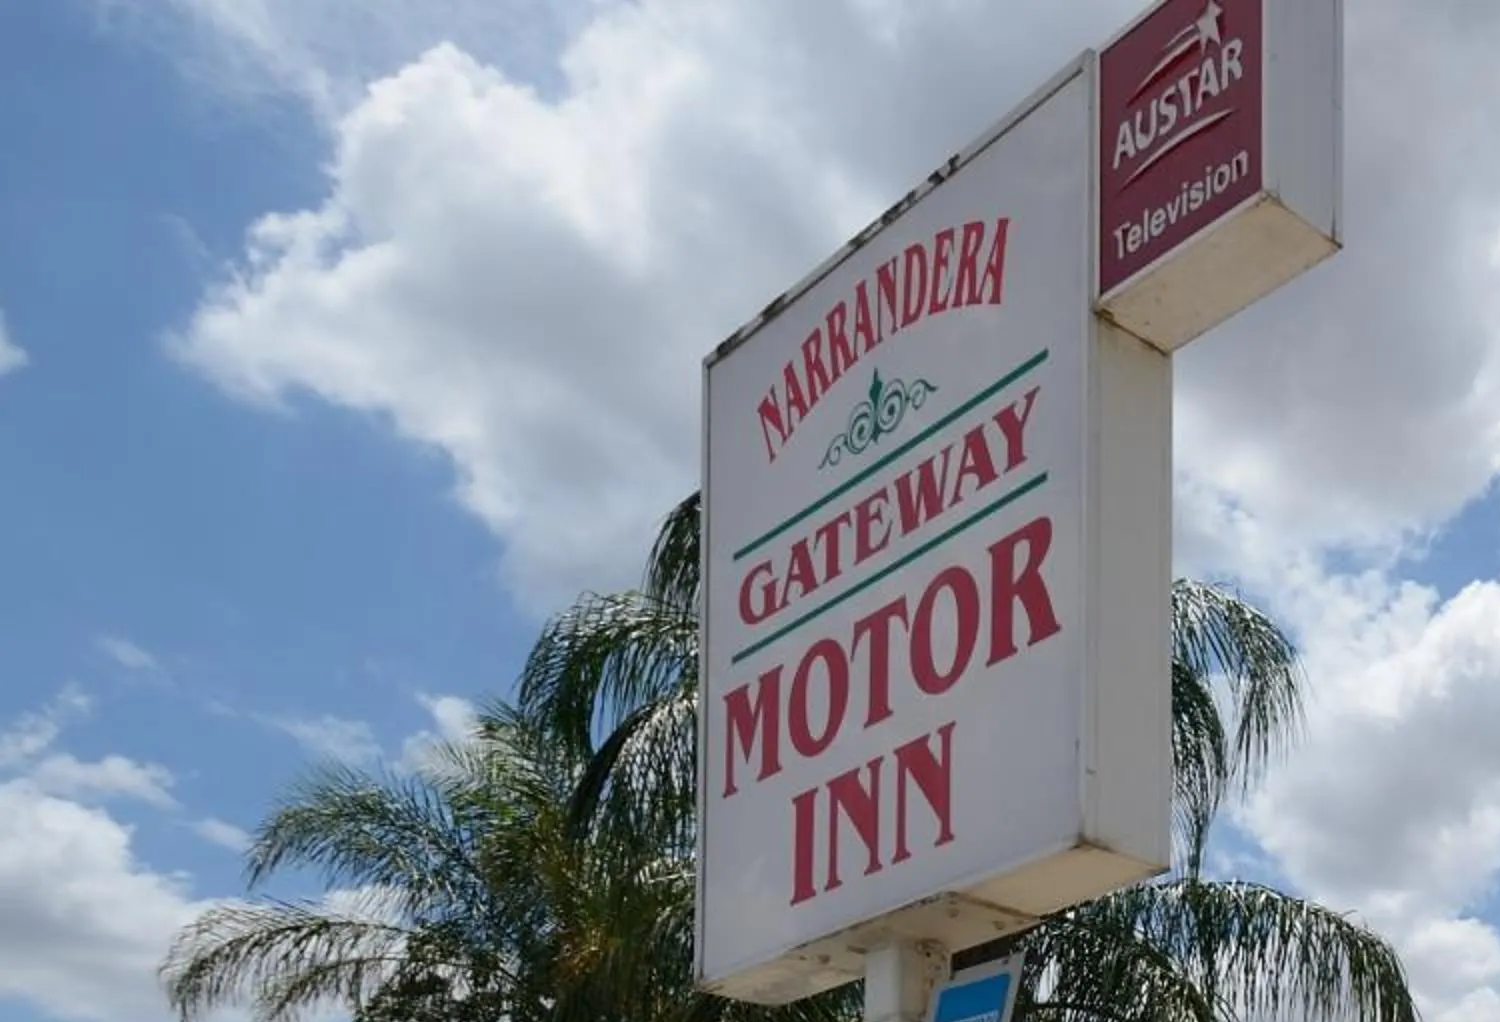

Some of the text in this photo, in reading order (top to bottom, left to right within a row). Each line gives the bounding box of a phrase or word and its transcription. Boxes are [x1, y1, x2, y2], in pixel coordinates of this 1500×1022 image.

[1113, 38, 1244, 169] AUSTAR
[1113, 149, 1249, 260] Television
[757, 217, 1010, 464] NARRANDERA
[738, 387, 1041, 625] GATEWAY
[722, 515, 1061, 798] MOTOR
[789, 721, 957, 907] INN
